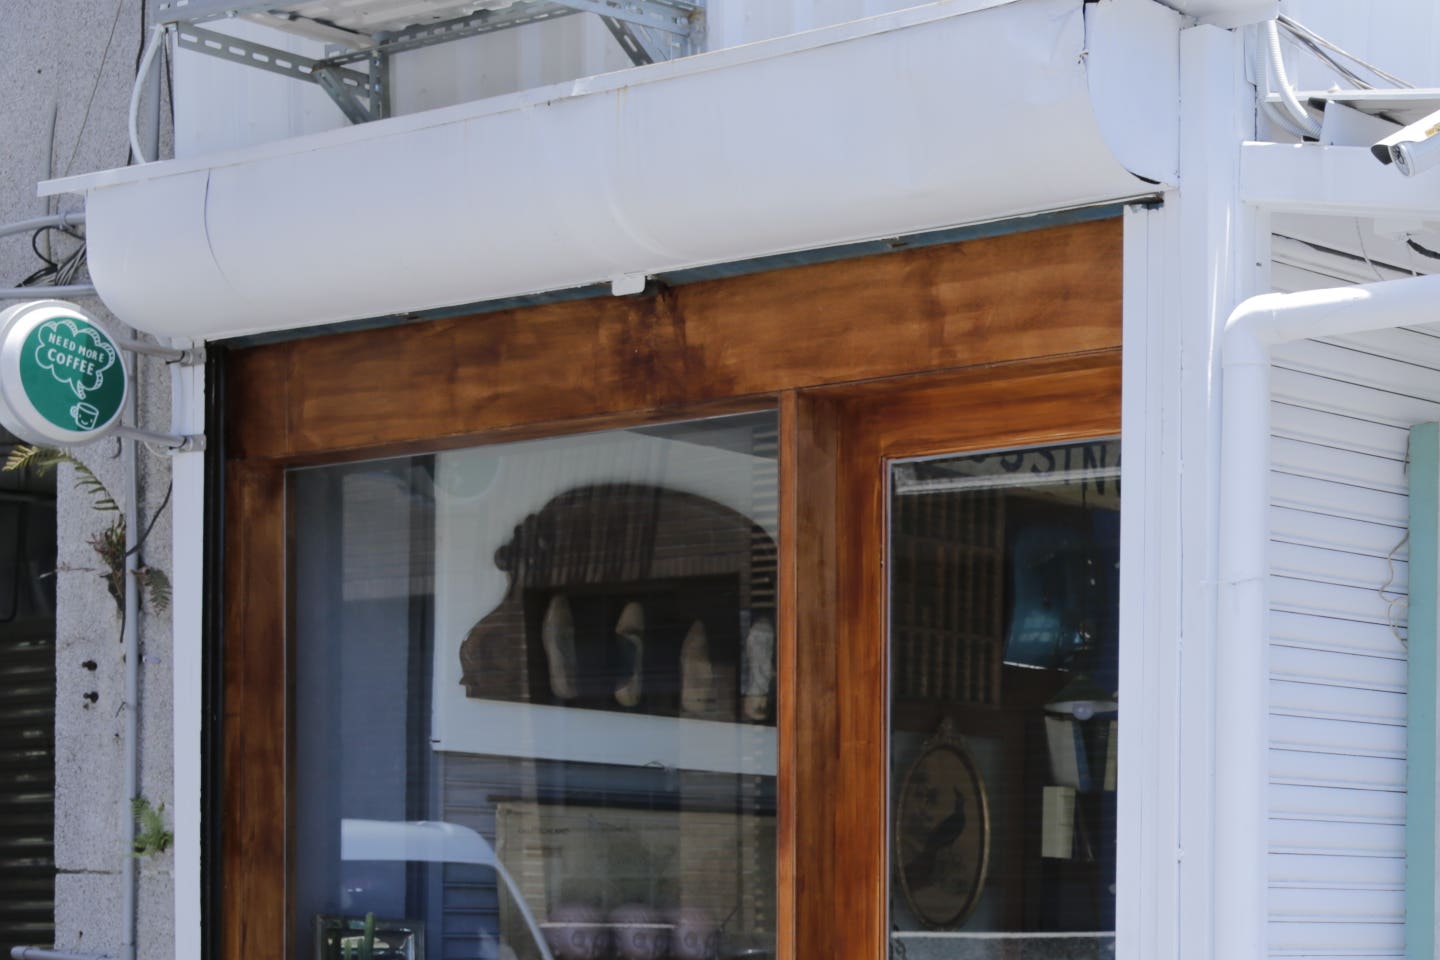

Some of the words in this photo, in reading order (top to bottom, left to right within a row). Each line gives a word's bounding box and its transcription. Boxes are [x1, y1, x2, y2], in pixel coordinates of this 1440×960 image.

[47, 348, 96, 376] COFFEE
[48, 333, 76, 351] NEED
[78, 344, 105, 363] MORE
